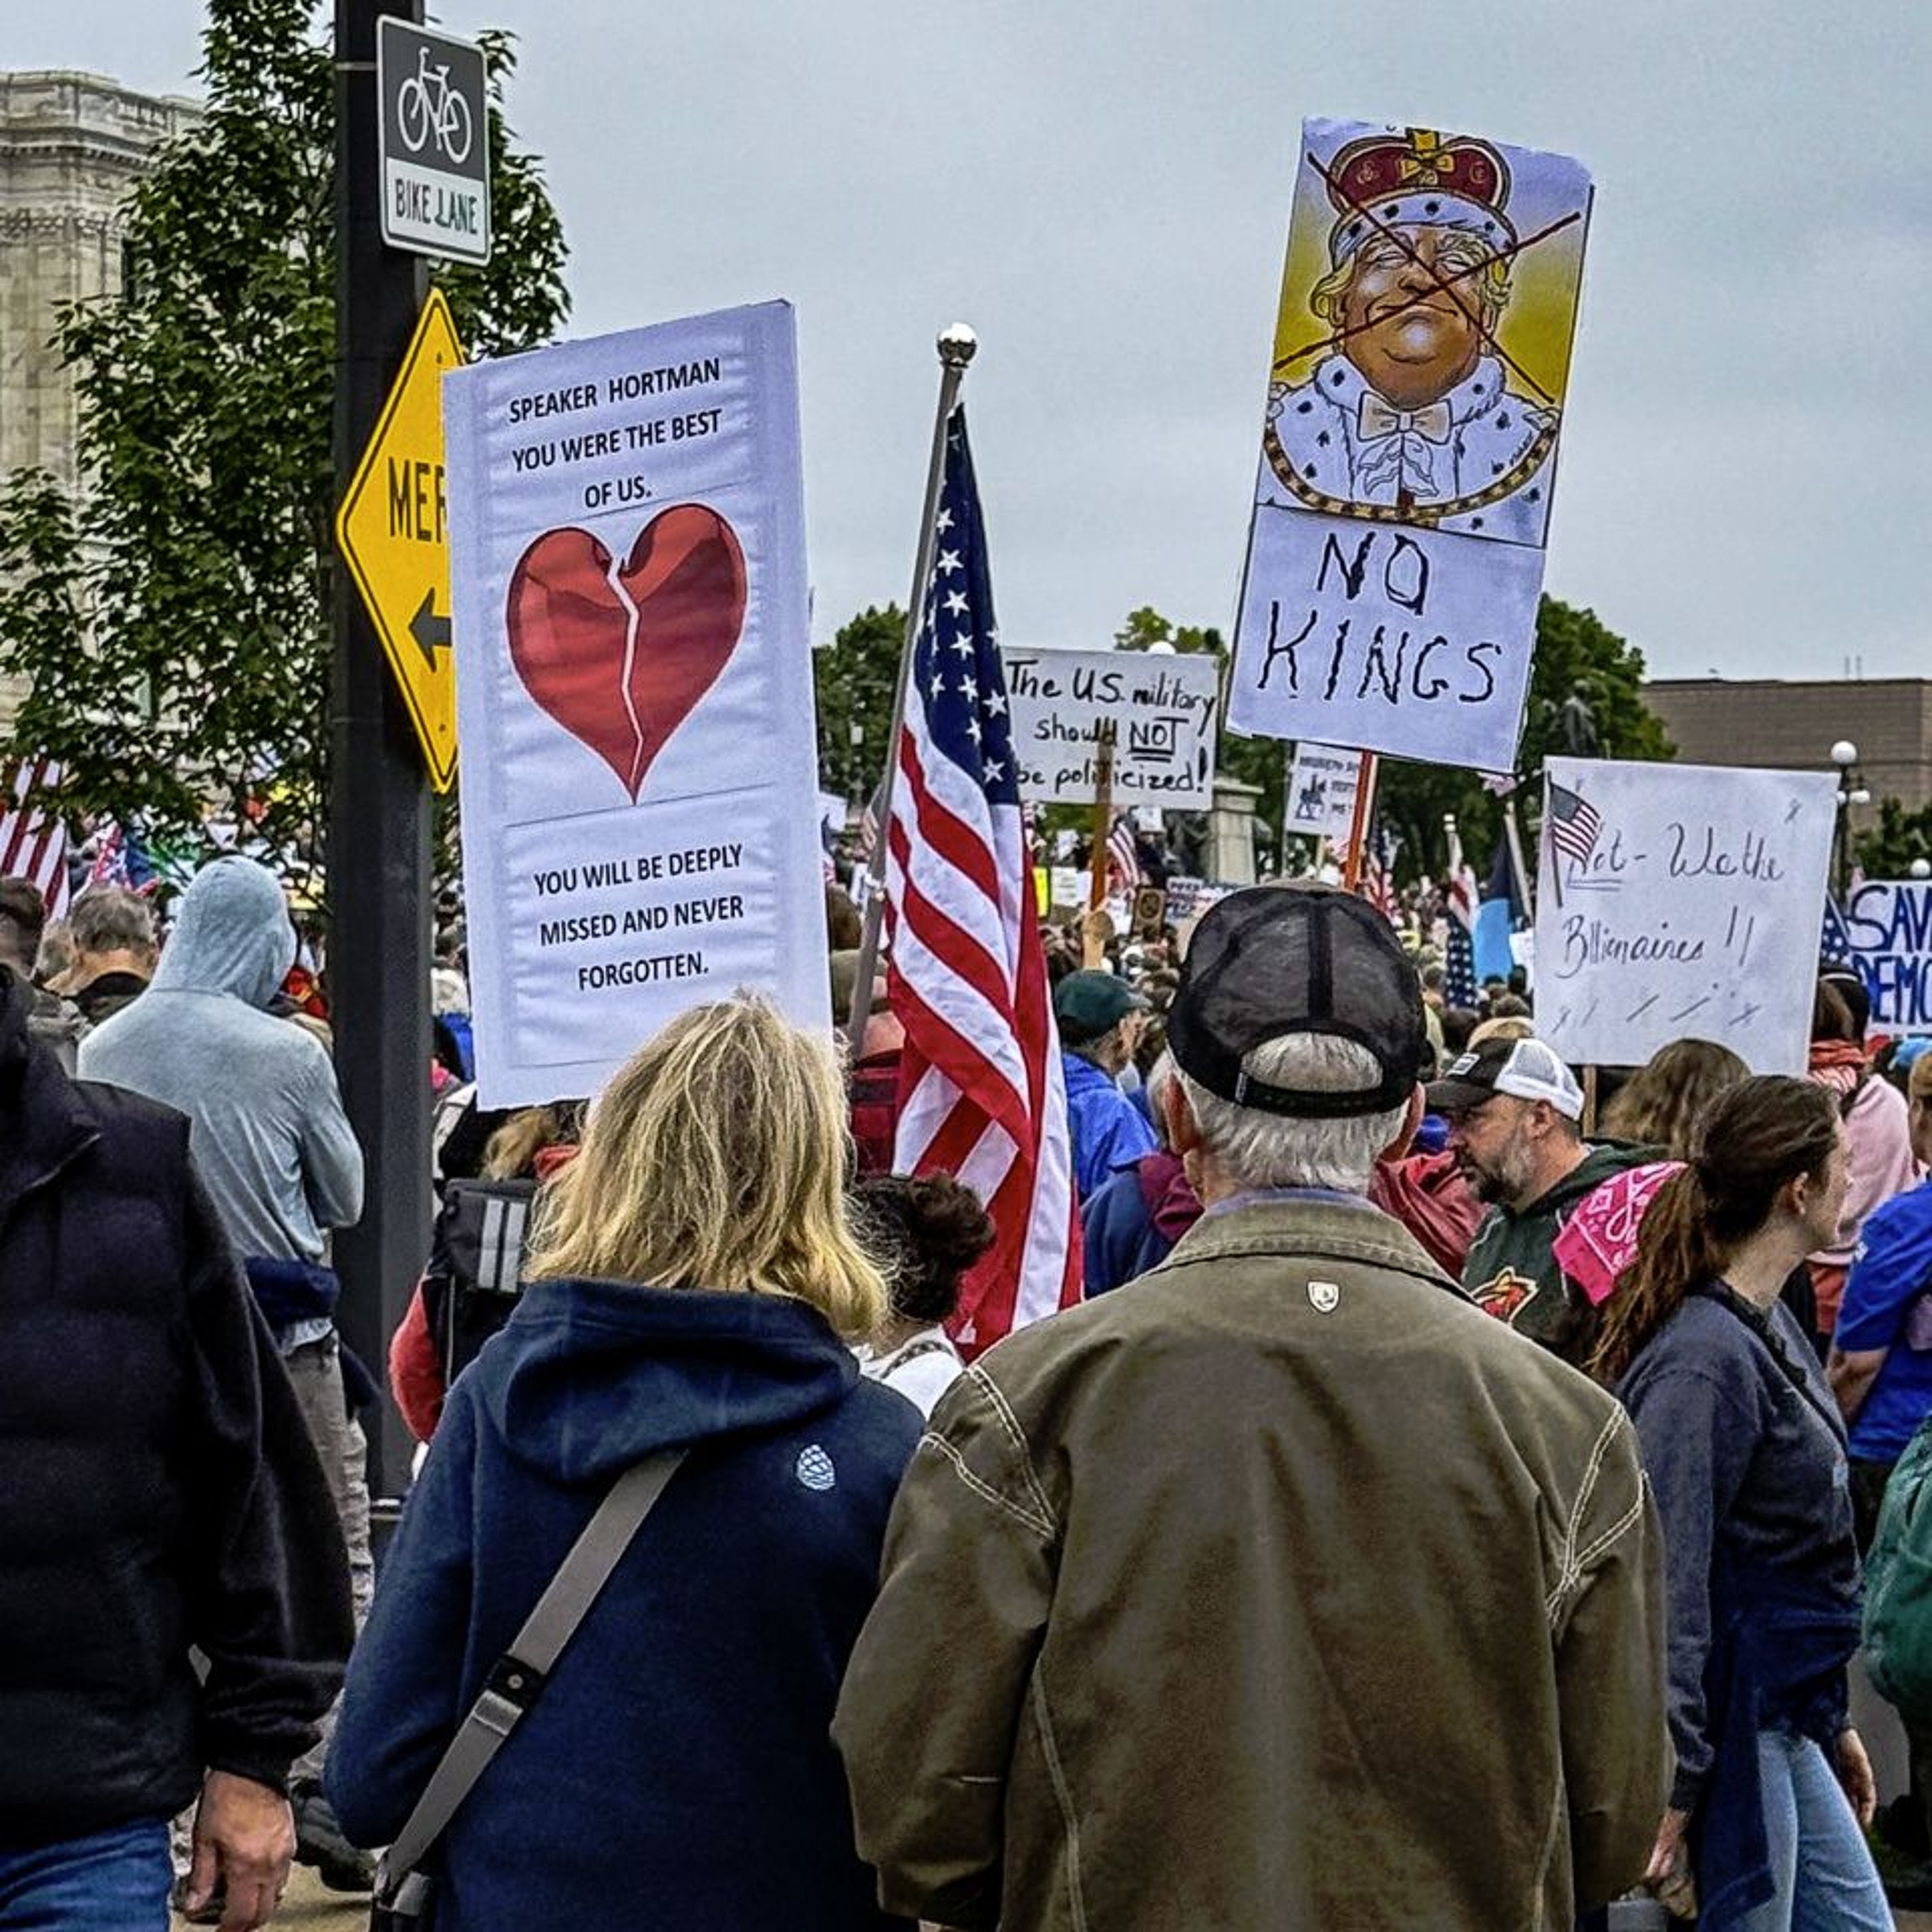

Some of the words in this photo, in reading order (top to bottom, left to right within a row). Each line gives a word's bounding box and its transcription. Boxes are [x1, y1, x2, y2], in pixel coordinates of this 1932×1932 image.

[395, 178, 431, 224] BIKE
[434, 187, 478, 235] LANE
[509, 384, 598, 424] SPEAKER
[609, 357, 720, 403] HORTMAN
[513, 442, 556, 472] YOU
[561, 430, 621, 462] WERE
[625, 420, 666, 450] THE
[671, 408, 723, 440] BEST
[584, 482, 612, 509] OF
[617, 475, 652, 503] US.
[1316, 532, 1429, 615] NO
[1257, 601, 1502, 705] KINGS
[1006, 659, 1063, 698] The
[1132, 671, 1216, 737] military
[1034, 712, 1118, 747] should
[1129, 716, 1189, 755] NOT
[1016, 761, 1045, 784] be
[534, 867, 577, 896] YOU
[582, 860, 632, 889] WILL
[638, 856, 662, 881] BE
[668, 843, 743, 876] DEEPLY
[540, 914, 617, 947] MISSED
[623, 907, 668, 934] AND
[674, 895, 744, 927] NEVER
[1848, 885, 1932, 953] SAV
[579, 952, 710, 992] FORGOTTEN.
